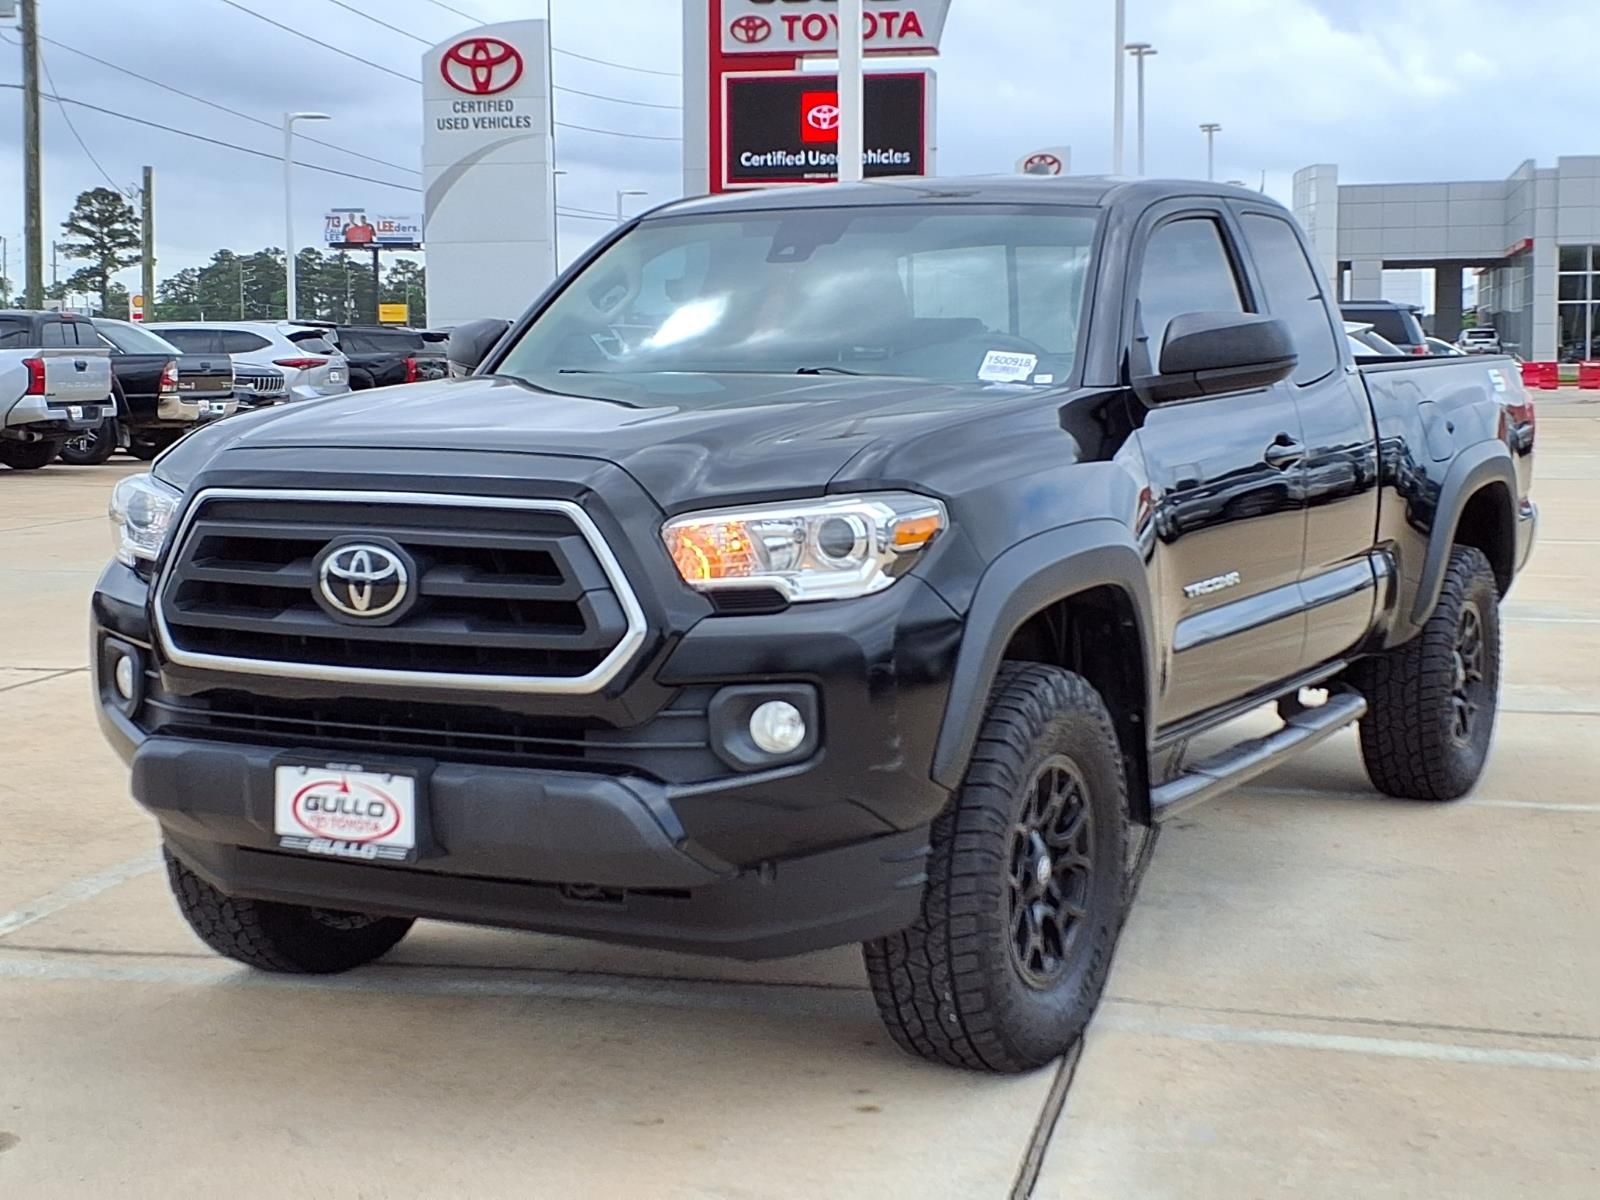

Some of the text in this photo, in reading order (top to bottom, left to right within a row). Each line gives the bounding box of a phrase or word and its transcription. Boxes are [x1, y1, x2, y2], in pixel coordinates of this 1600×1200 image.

[452, 99, 514, 114] CERTIFIED
[436, 115, 532, 131] USED VEHICLES
[740, 148, 911, 167] Certified Use ehicles
[304, 796, 386, 818] GULLO
